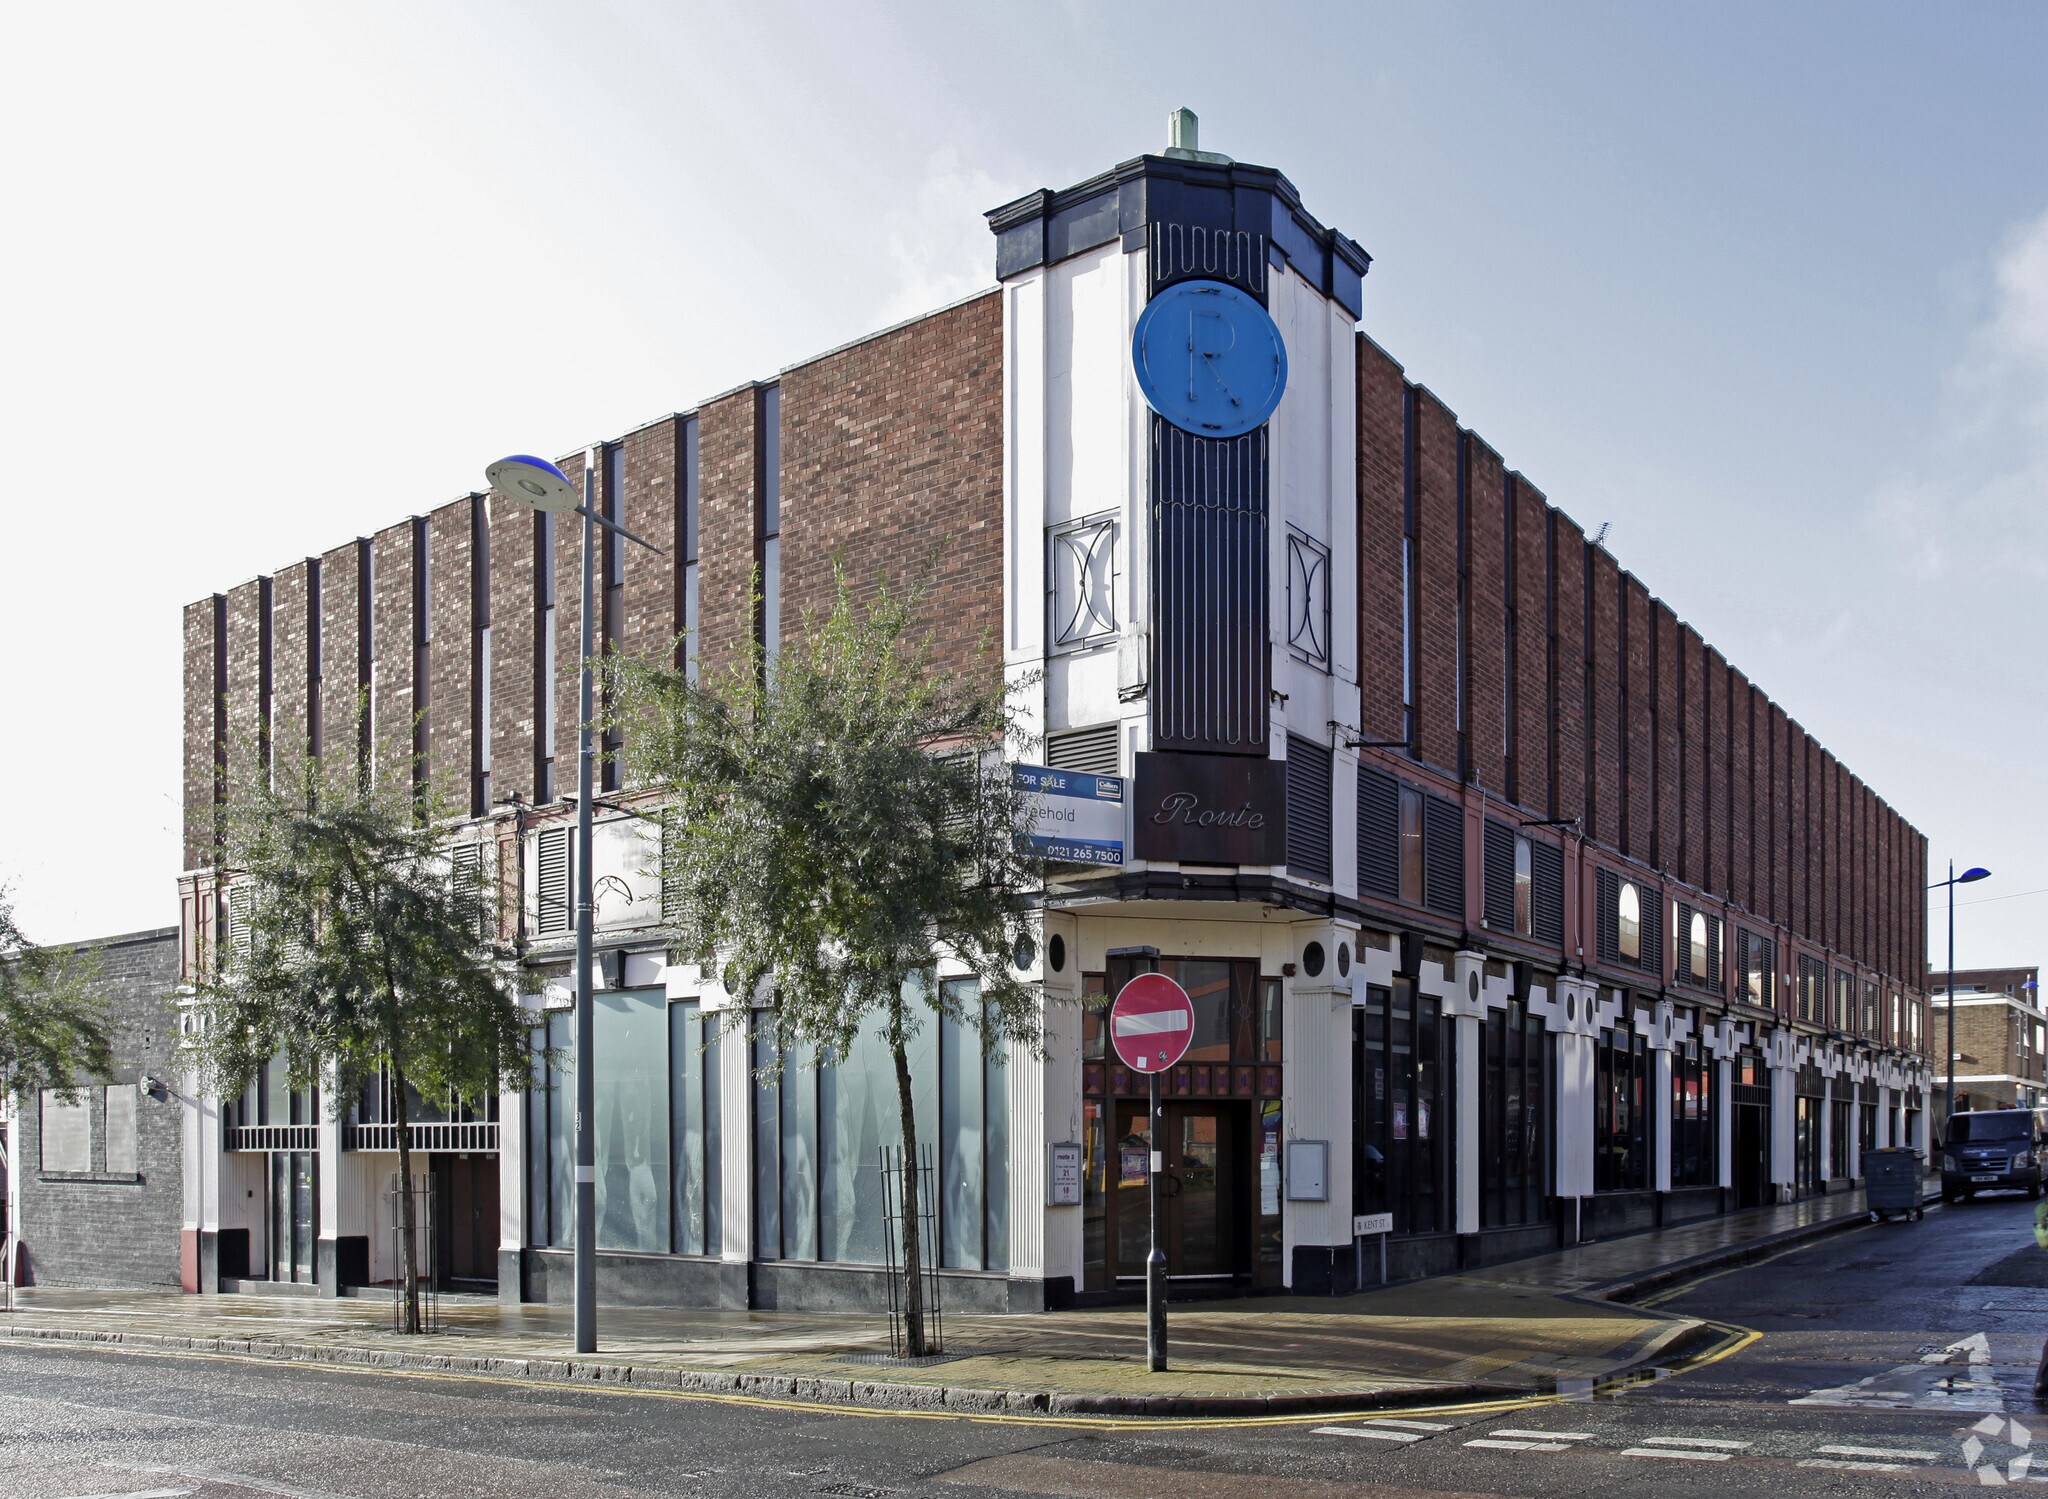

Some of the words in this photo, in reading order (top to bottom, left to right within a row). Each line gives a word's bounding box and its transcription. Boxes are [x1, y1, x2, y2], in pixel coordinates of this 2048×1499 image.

[1016, 774, 1037, 785] FOR
[1040, 776, 1066, 789] SALE
[1153, 792, 1265, 829] Route
[1047, 845, 1070, 857] 0121
[1073, 848, 1092, 859] 265
[1095, 850, 1120, 862] 7500
[1364, 1220, 1378, 1230] KENT
[1379, 1219, 1385, 1228] ST
